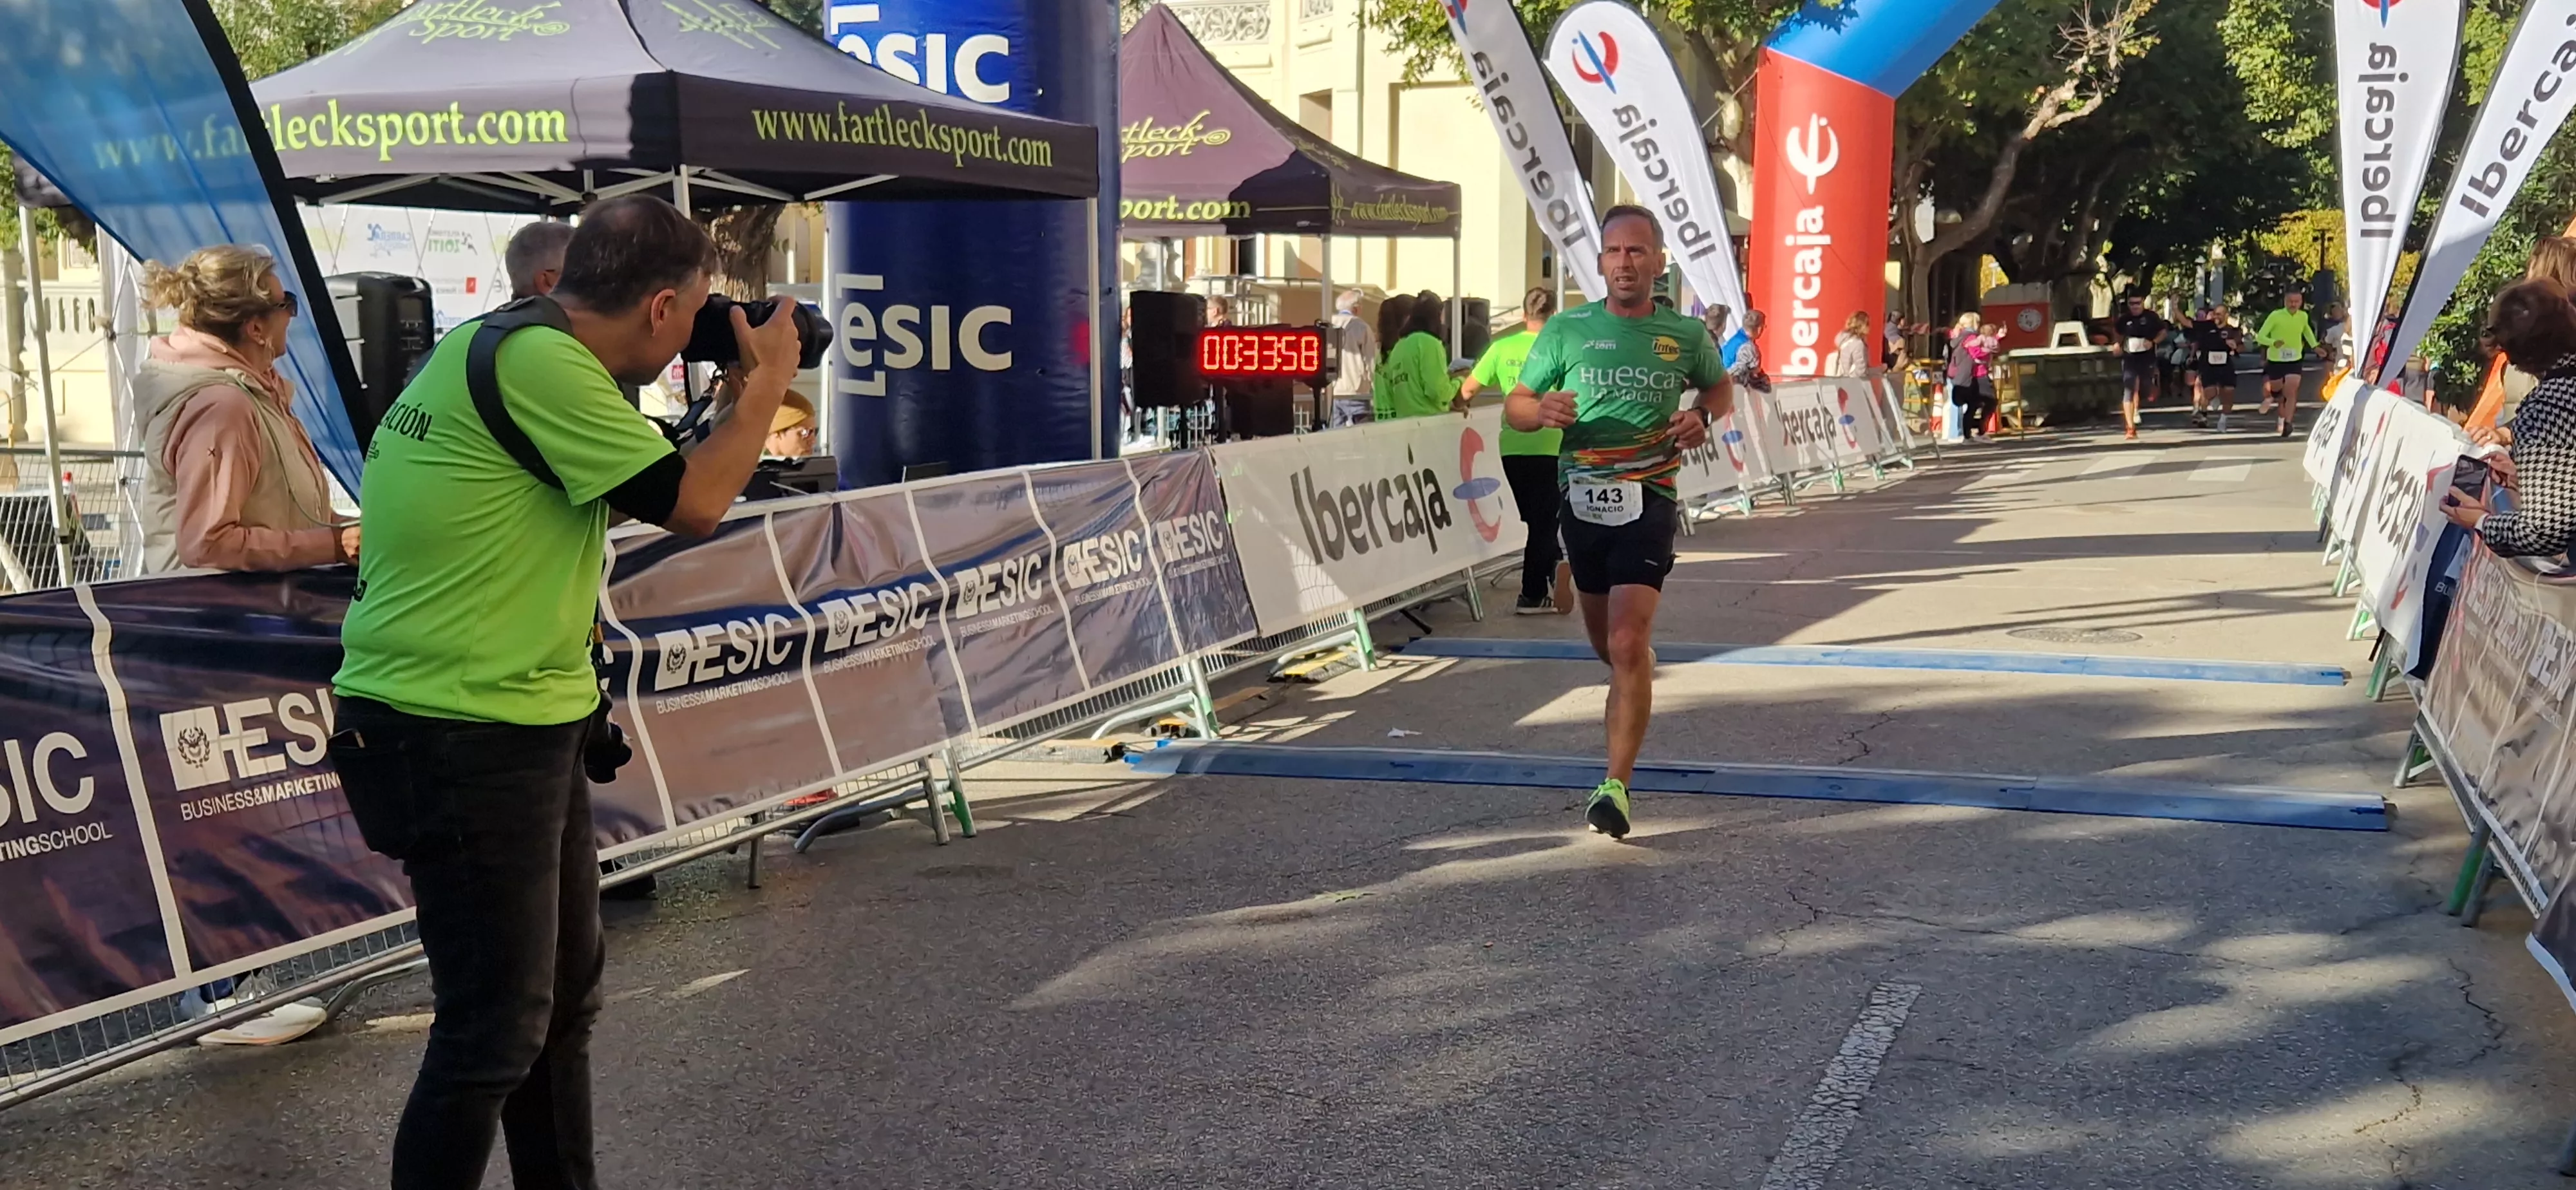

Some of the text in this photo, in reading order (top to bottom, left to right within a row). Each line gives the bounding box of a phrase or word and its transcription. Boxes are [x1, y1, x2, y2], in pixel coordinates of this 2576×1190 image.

[92, 99, 569, 169] www.falecksport.com
[751, 101, 1053, 167] www.fartlecksport.com
[2459, 14, 2576, 219] Iberca
[1121, 140, 1197, 164] port
[1781, 205, 1832, 376] bercaja
[1203, 335, 1319, 371] 00:33:58
[1290, 442, 1452, 565] Ibercaja
[1585, 487, 1624, 504] 143
[1586, 505, 1624, 513] IGNACIO
[1083, 529, 1142, 583] ESIC
[1173, 510, 1224, 562] ESIC
[848, 582, 933, 645] ESIC
[980, 552, 1042, 613] ESIC
[690, 613, 793, 683] ESIC
